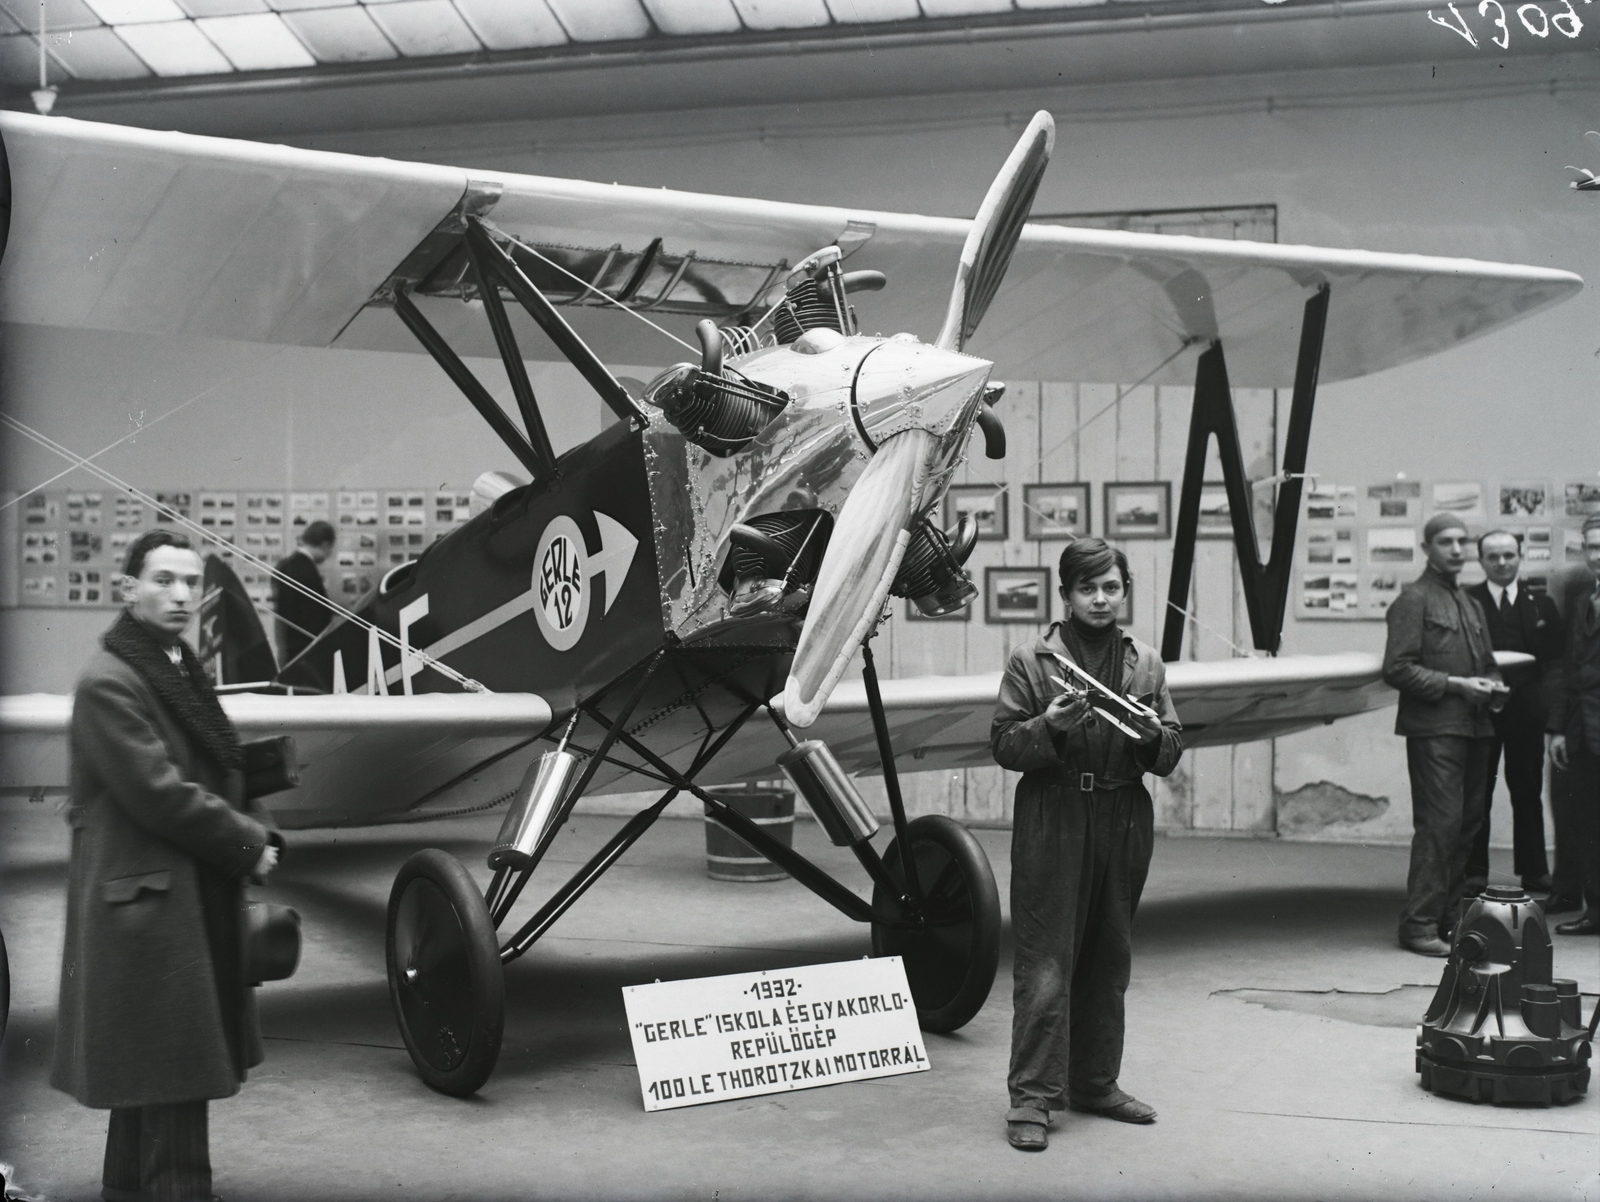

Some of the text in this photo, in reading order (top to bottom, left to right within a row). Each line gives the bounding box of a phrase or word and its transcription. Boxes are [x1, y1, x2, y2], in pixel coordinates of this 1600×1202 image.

[539, 536, 581, 612] GERLE
[554, 584, 573, 629] 12
[635, 1013, 712, 1043] "GERLE"
[715, 1008, 783, 1034] ISKOLA
[786, 999, 811, 1025] ÉS
[648, 1077, 687, 1101] 100
[689, 1073, 715, 1097] LE
[717, 1058, 832, 1091] THOROTZKAI
